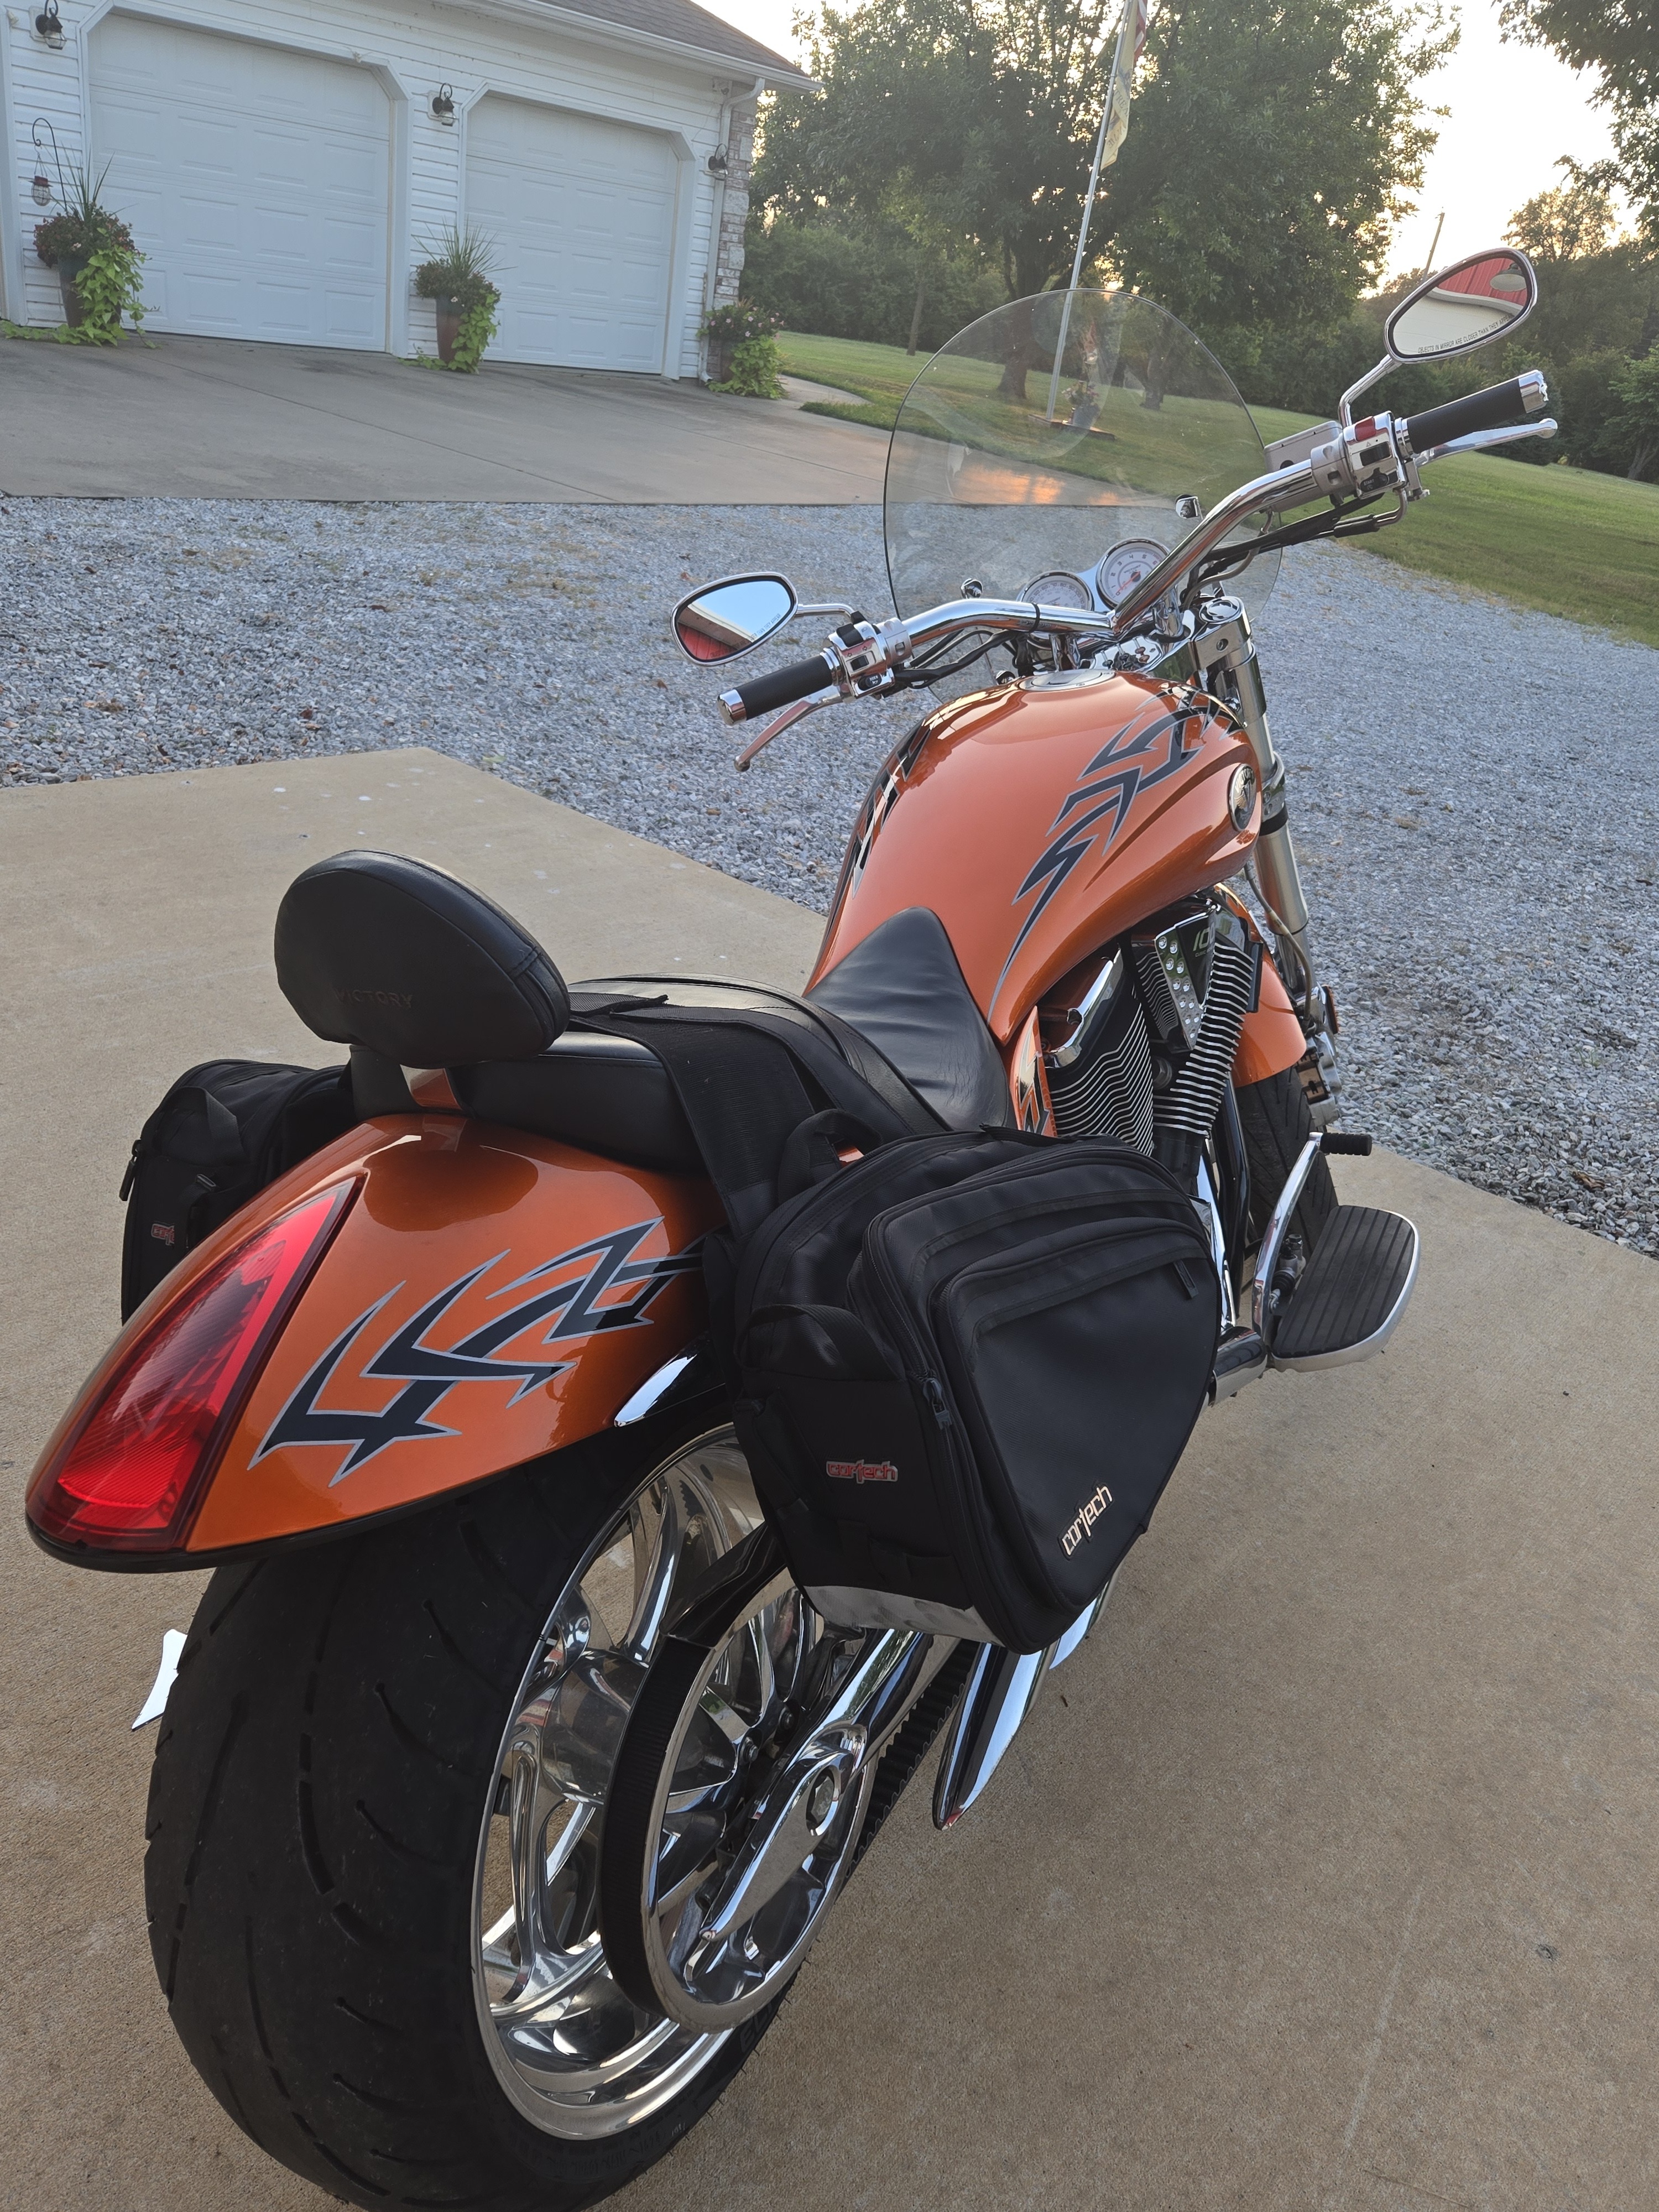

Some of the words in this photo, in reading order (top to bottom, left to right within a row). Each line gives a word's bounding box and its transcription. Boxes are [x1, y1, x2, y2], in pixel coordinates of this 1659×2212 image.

[1114, 88, 1129, 117] TREA
[1418, 345, 1434, 353] OBJECTS
[1440, 340, 1454, 349] MIRROR
[1463, 332, 1478, 342] CLOSER
[1478, 327, 1489, 336] THAN
[1234, 768, 1254, 794] VICTORY
[333, 988, 413, 1009] VICTORY
[827, 1460, 897, 1483] cortech
[1062, 1486, 1113, 1555] cortech
